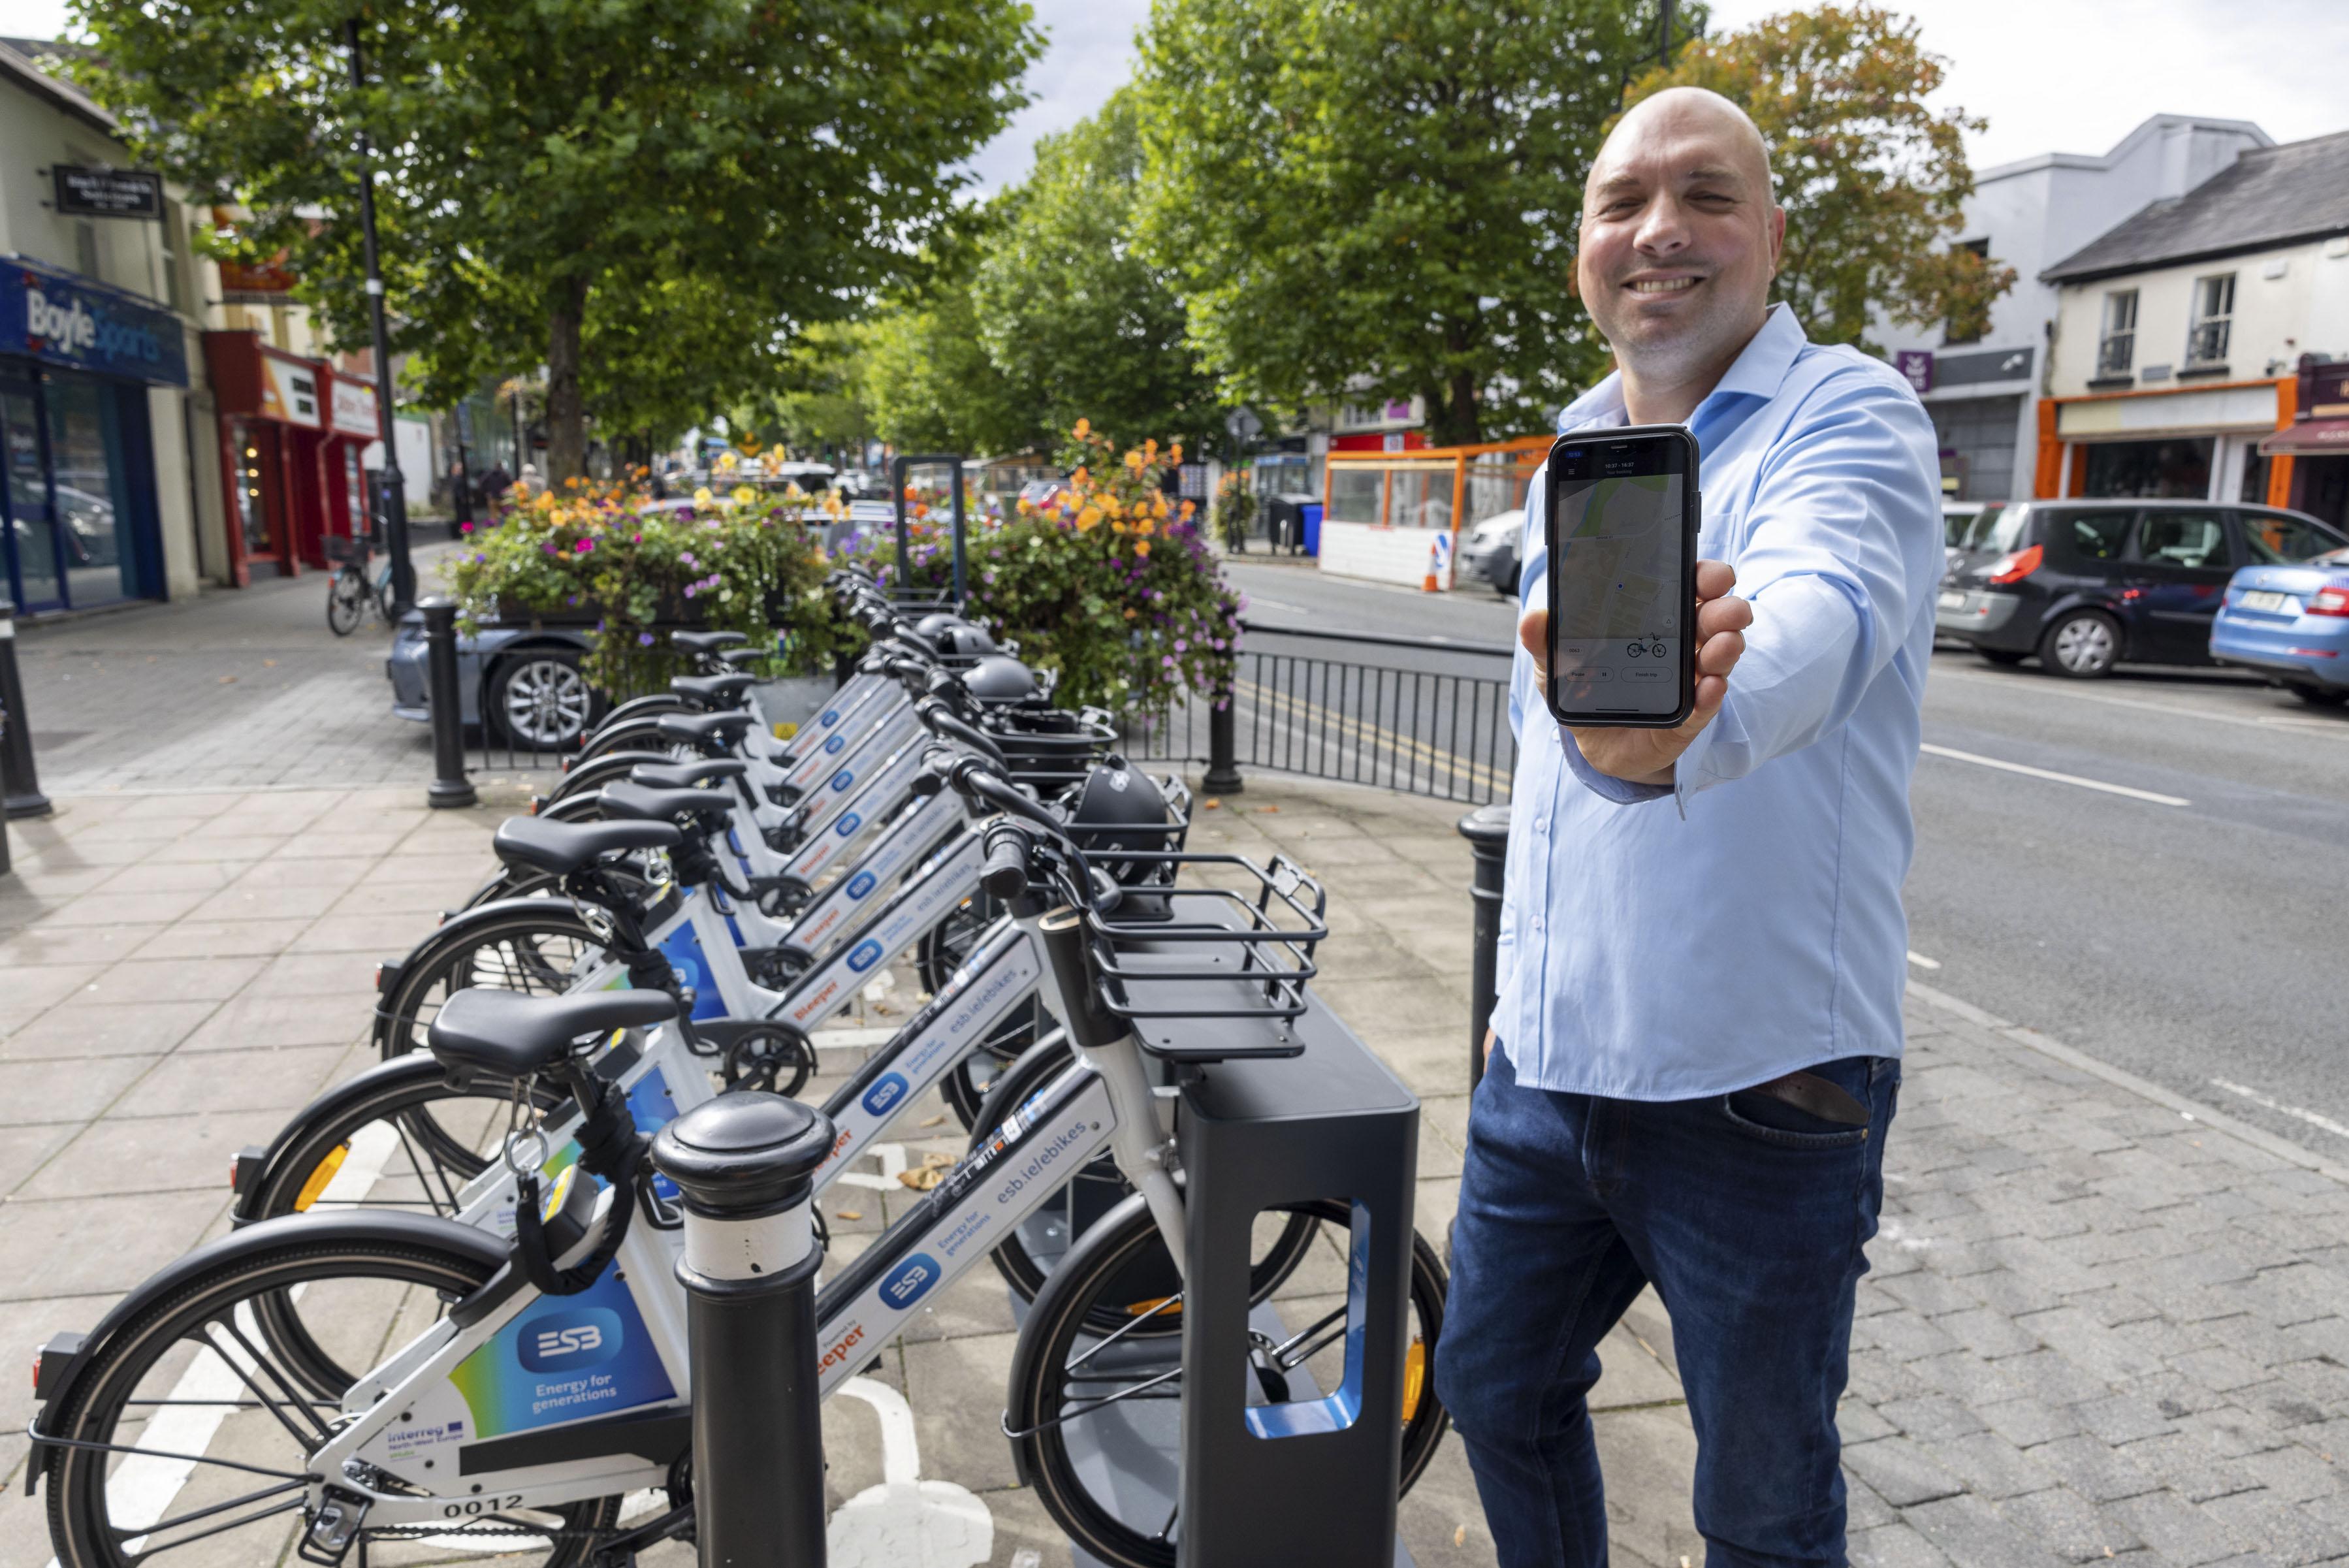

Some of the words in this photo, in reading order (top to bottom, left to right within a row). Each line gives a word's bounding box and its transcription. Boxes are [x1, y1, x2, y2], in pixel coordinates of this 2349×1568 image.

[27, 288, 159, 363] BoyleSports
[950, 970, 1016, 1033] esb.ie/ebikes
[870, 1081, 900, 1109] ESB
[997, 1121, 1087, 1204] esb.ie/ebikes
[938, 1221, 968, 1249] Energy
[967, 1211, 979, 1224] for
[946, 1213, 992, 1257] generations
[890, 1266, 928, 1300] ESB
[537, 1325, 602, 1358] ESB
[532, 1386, 617, 1415] generations
[535, 1379, 588, 1397] Energy
[590, 1374, 613, 1386] for
[444, 1494, 523, 1518] 0012
